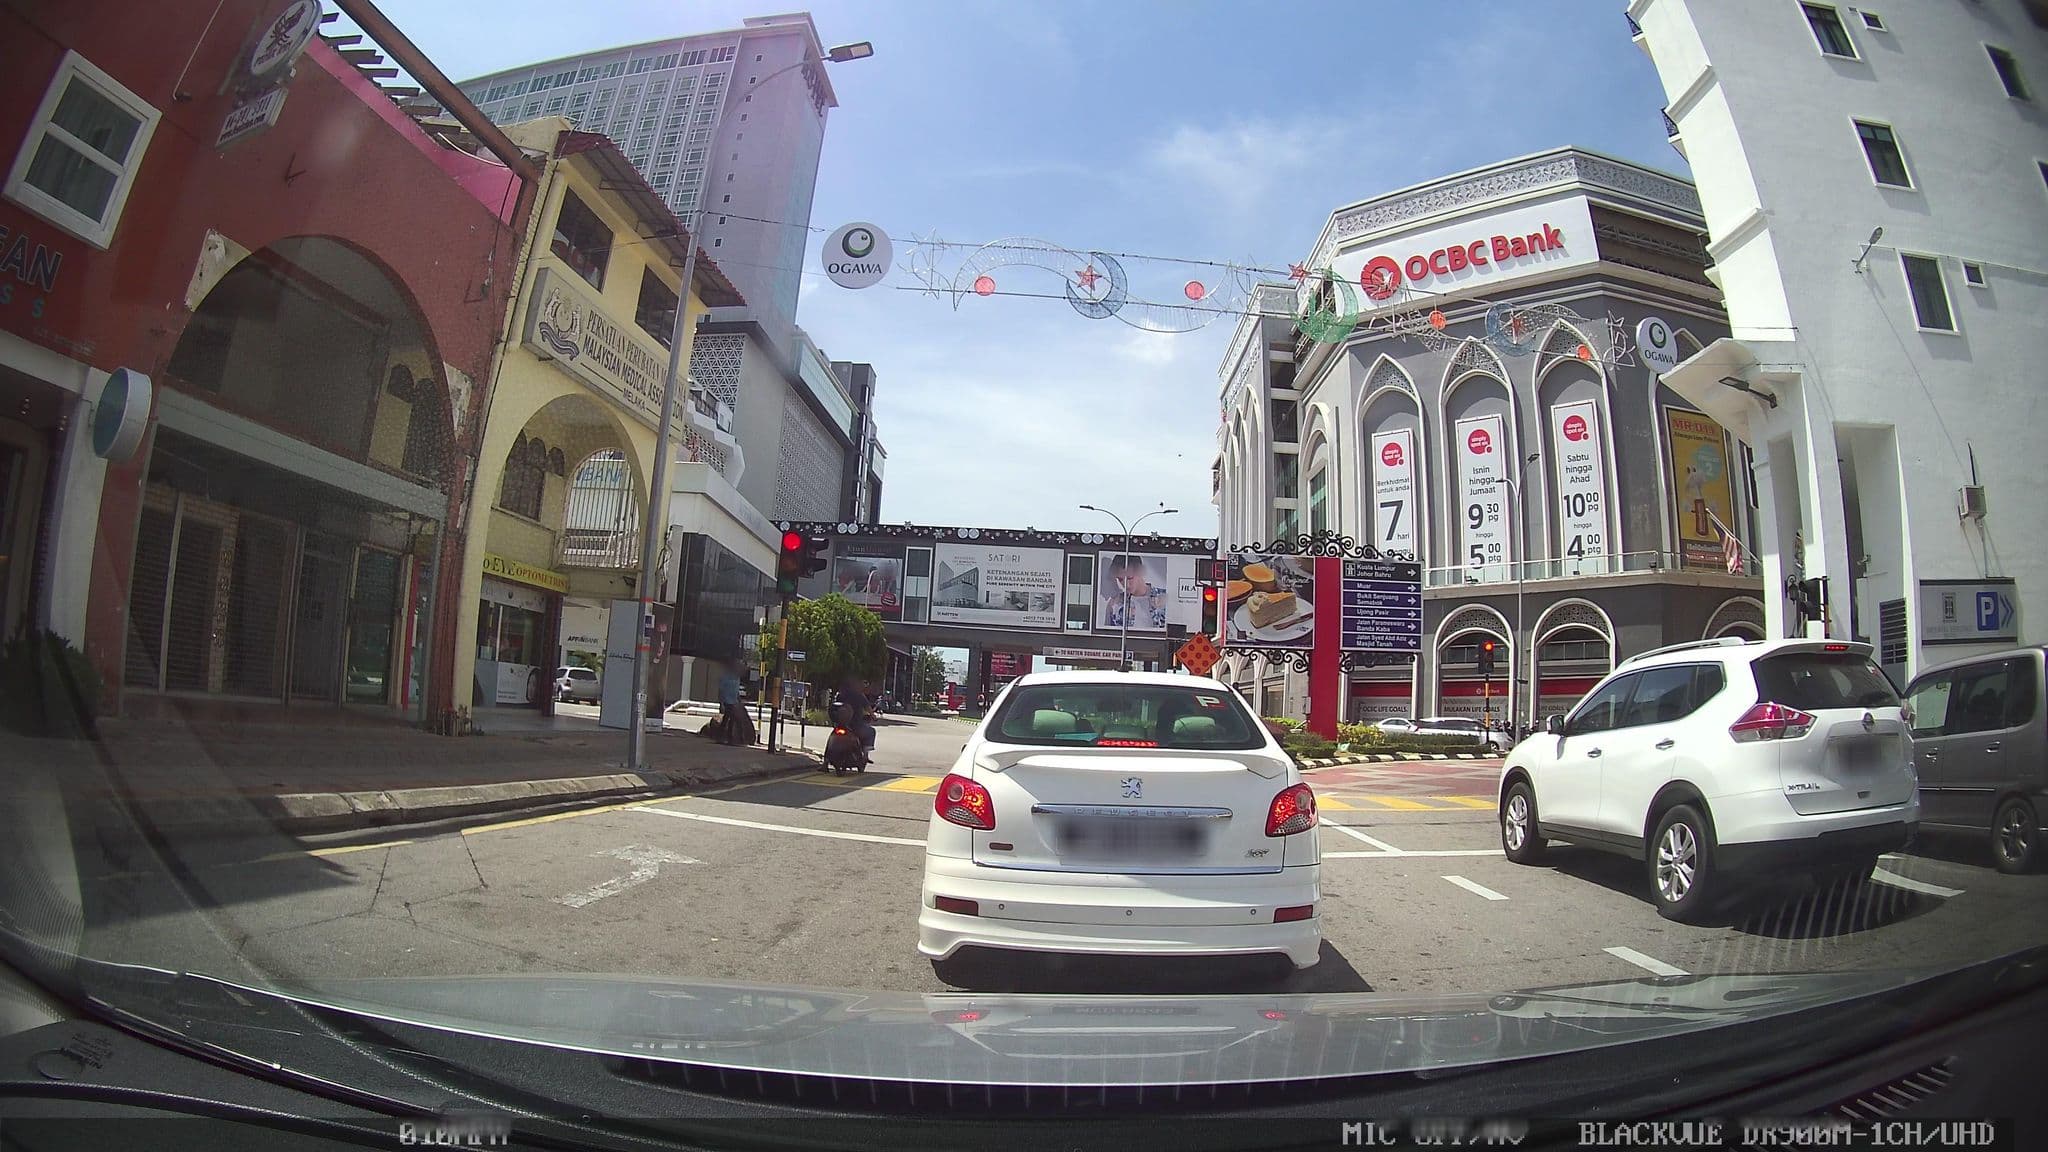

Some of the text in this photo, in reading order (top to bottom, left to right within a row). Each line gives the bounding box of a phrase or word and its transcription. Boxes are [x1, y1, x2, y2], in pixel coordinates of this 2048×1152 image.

[1405, 222, 1564, 282] OCBC Bank
[828, 263, 882, 274] OGAWA
[587, 310, 625, 354] PERSATUAN
[625, 341, 659, 381] PERUBATAN
[1645, 350, 1674, 364] OGAWA
[583, 334, 620, 377] MALAYSIAN
[621, 362, 646, 396] MEDICAL
[622, 387, 646, 411] MELAKA
[1567, 453, 1589, 462] Sabtu
[1472, 466, 1490, 475] Isnin
[1566, 464, 1592, 474] hingga
[1377, 478, 1410, 487] Berkhidmat
[1469, 476, 1495, 486] hingga
[1570, 474, 1590, 484] Ahad
[1470, 486, 1496, 496] Jumaat
[1564, 492, 1599, 518] 10 00
[1588, 503, 1599, 512] pg
[1380, 500, 1403, 541] 7
[1468, 503, 1499, 530] 9 30
[1488, 514, 1499, 523] pg
[1567, 534, 1600, 561] 4 00
[1587, 546, 1601, 555] ptg
[1470, 542, 1501, 570] 5 00
[1488, 554, 1502, 563] ptg
[1375, 564, 1396, 572] Lumpur
[516, 567, 569, 590] OPTOMETRIST
[1981, 596, 1995, 626] P
[1195, 695, 1220, 707] P
